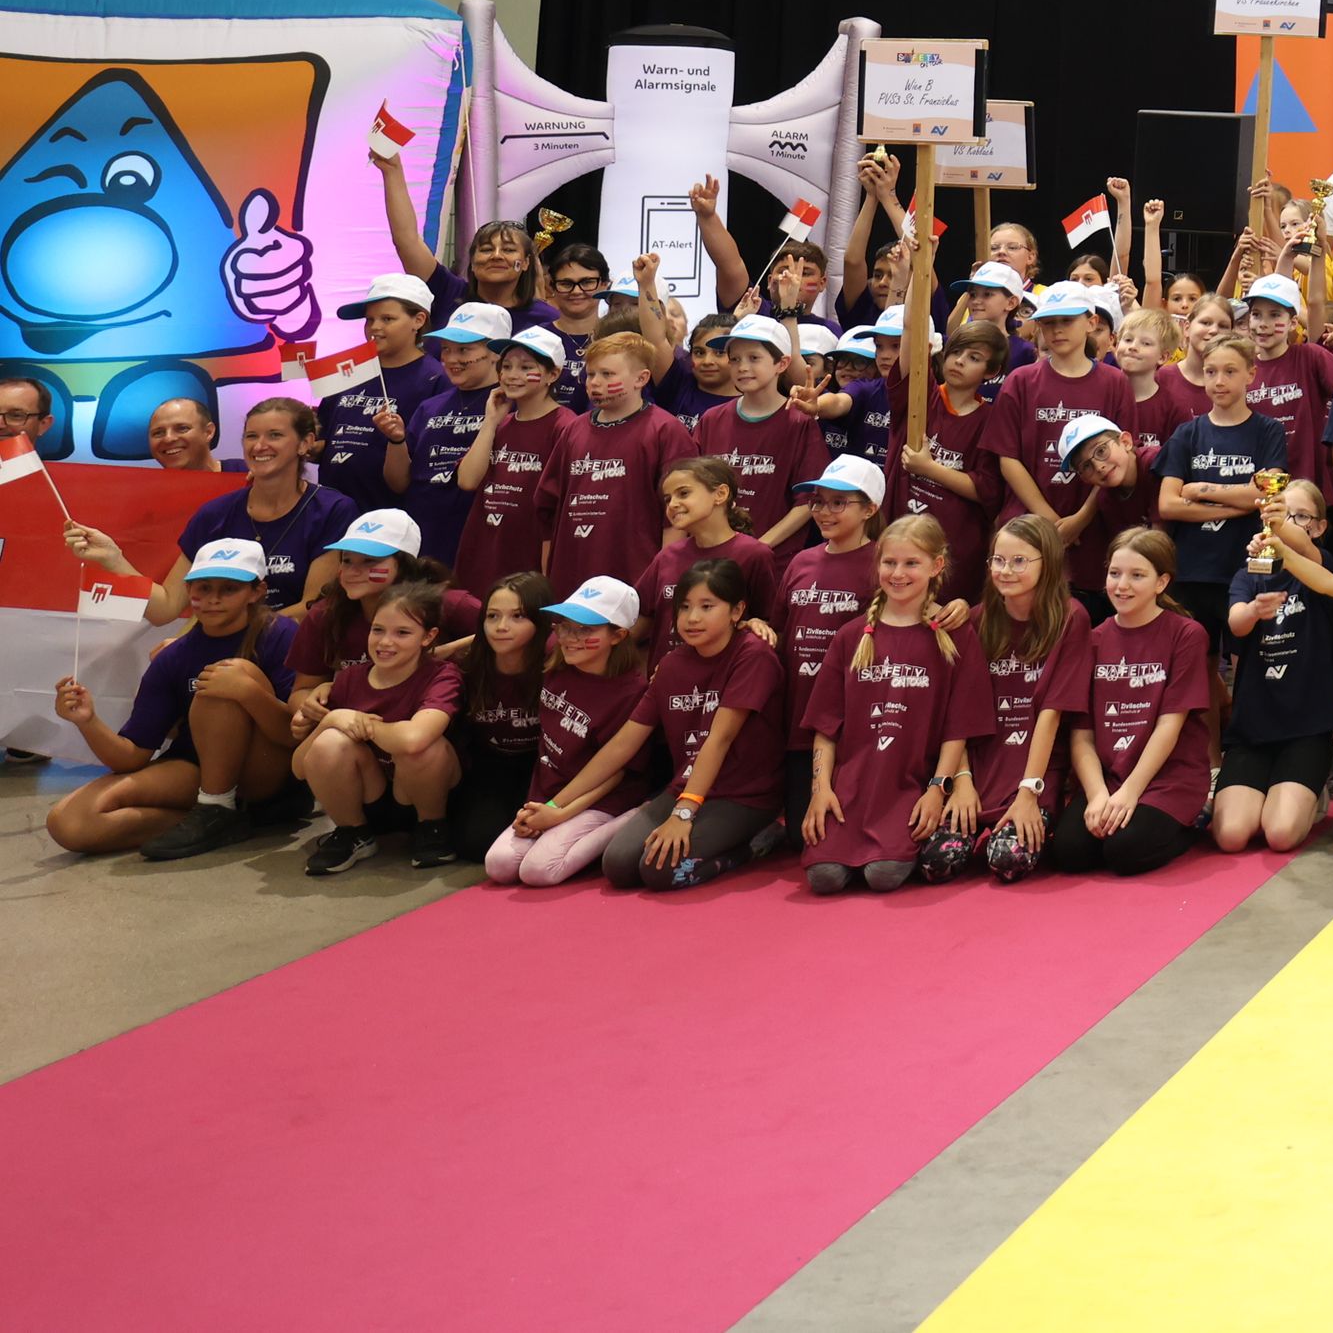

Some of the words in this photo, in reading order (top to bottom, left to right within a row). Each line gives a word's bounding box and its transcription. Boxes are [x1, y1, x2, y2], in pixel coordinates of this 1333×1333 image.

[642, 64, 684, 76] Warn-
[687, 65, 710, 77] und
[634, 78, 717, 94] Alarmsignale
[904, 79, 922, 91] Wien
[925, 79, 934, 92] B
[903, 94, 915, 106] St.
[919, 94, 959, 107] Franziskus
[525, 121, 586, 131] WARNUNG
[771, 129, 809, 142] ALARM
[541, 142, 579, 151] Minuten
[953, 145, 964, 156] VS
[967, 145, 994, 156] Koblach
[776, 150, 806, 161] Minute
[651, 240, 693, 250] AT-Alert
